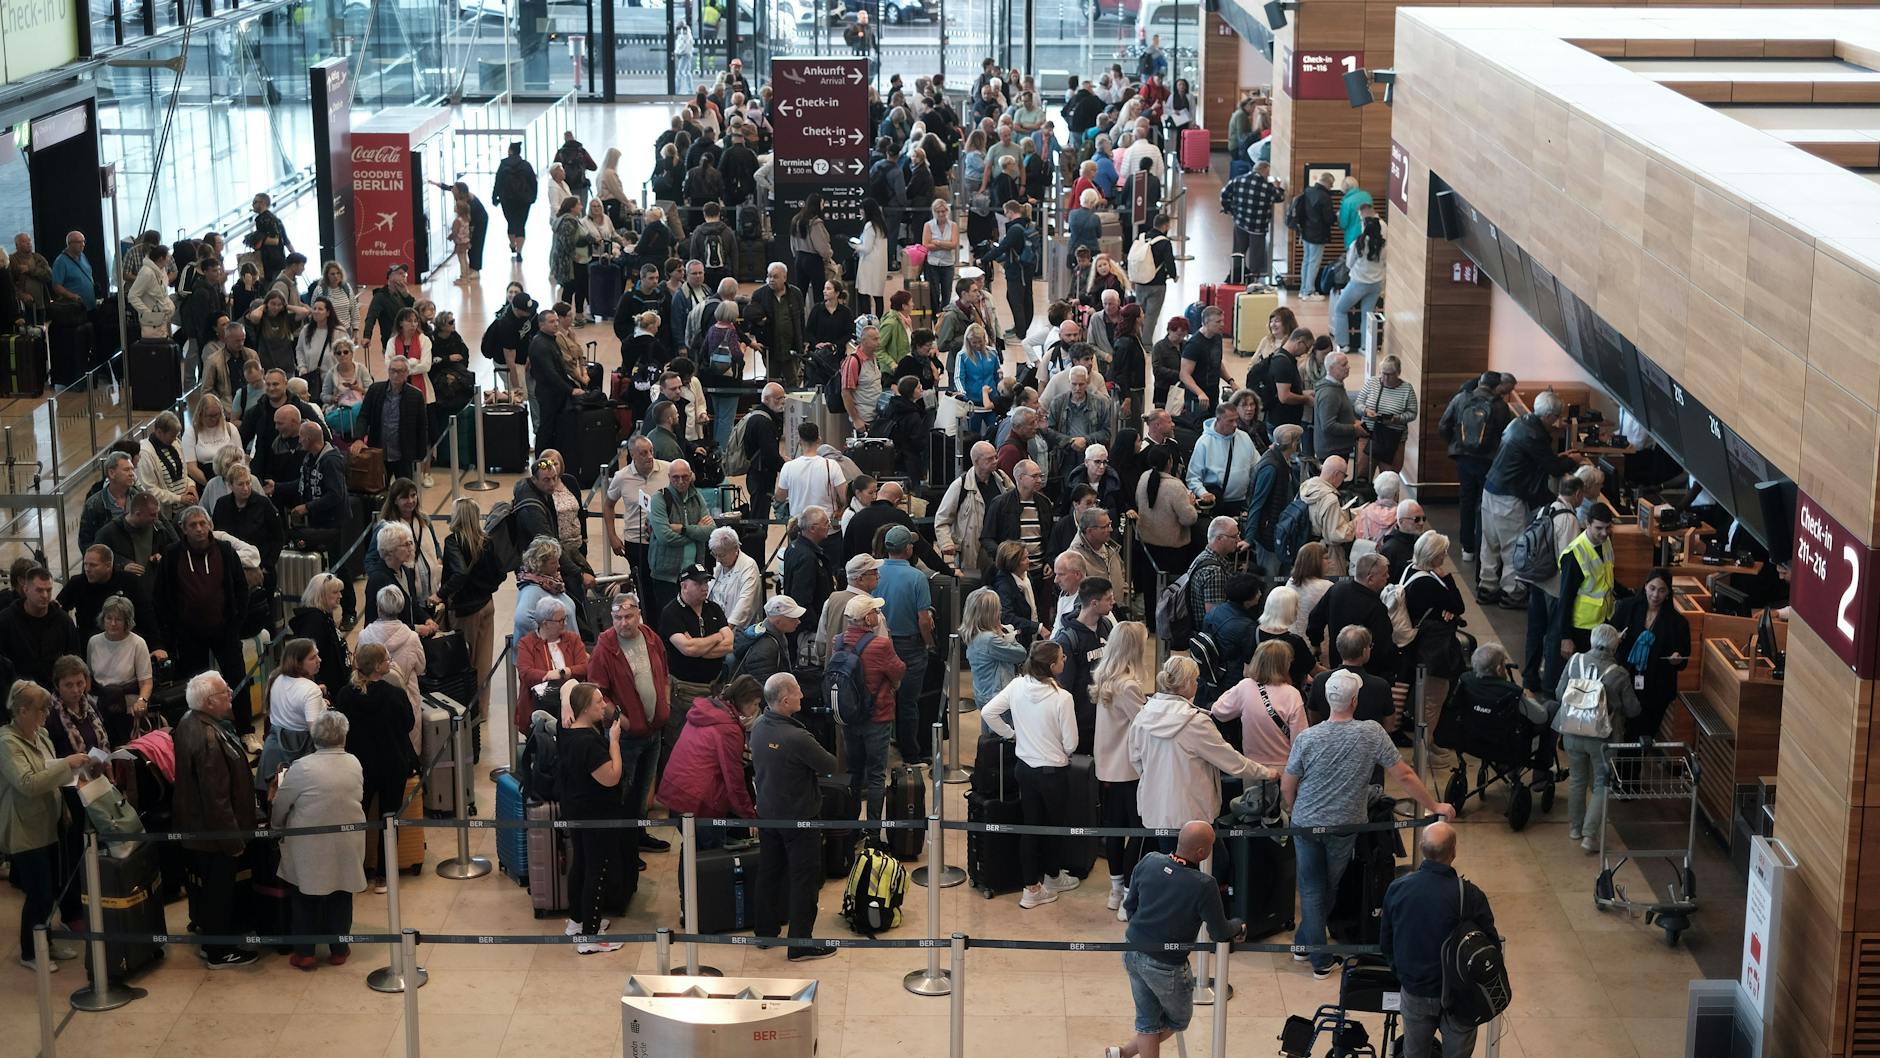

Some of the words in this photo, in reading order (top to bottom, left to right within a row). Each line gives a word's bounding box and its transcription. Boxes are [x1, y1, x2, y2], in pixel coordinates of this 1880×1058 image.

[803, 66, 845, 76] Ankunft
[795, 98, 839, 107] Check-in
[795, 109, 802, 118] 0
[802, 126, 846, 136] Check-in
[351, 145, 403, 163] Coca-Cola
[779, 158, 812, 166] Terminal
[353, 170, 403, 179] GOODBYE
[353, 179, 404, 191] BERLIN
[374, 241, 386, 249] Fly
[361, 248, 400, 256] refreshed!
[1673, 384, 1684, 406] 215
[1708, 415, 1721, 439] 216
[1797, 538, 1826, 581] 211–216
[1800, 504, 1833, 552] Check-in
[1837, 545, 1859, 643] 2
[754, 1030, 777, 1041] BER
